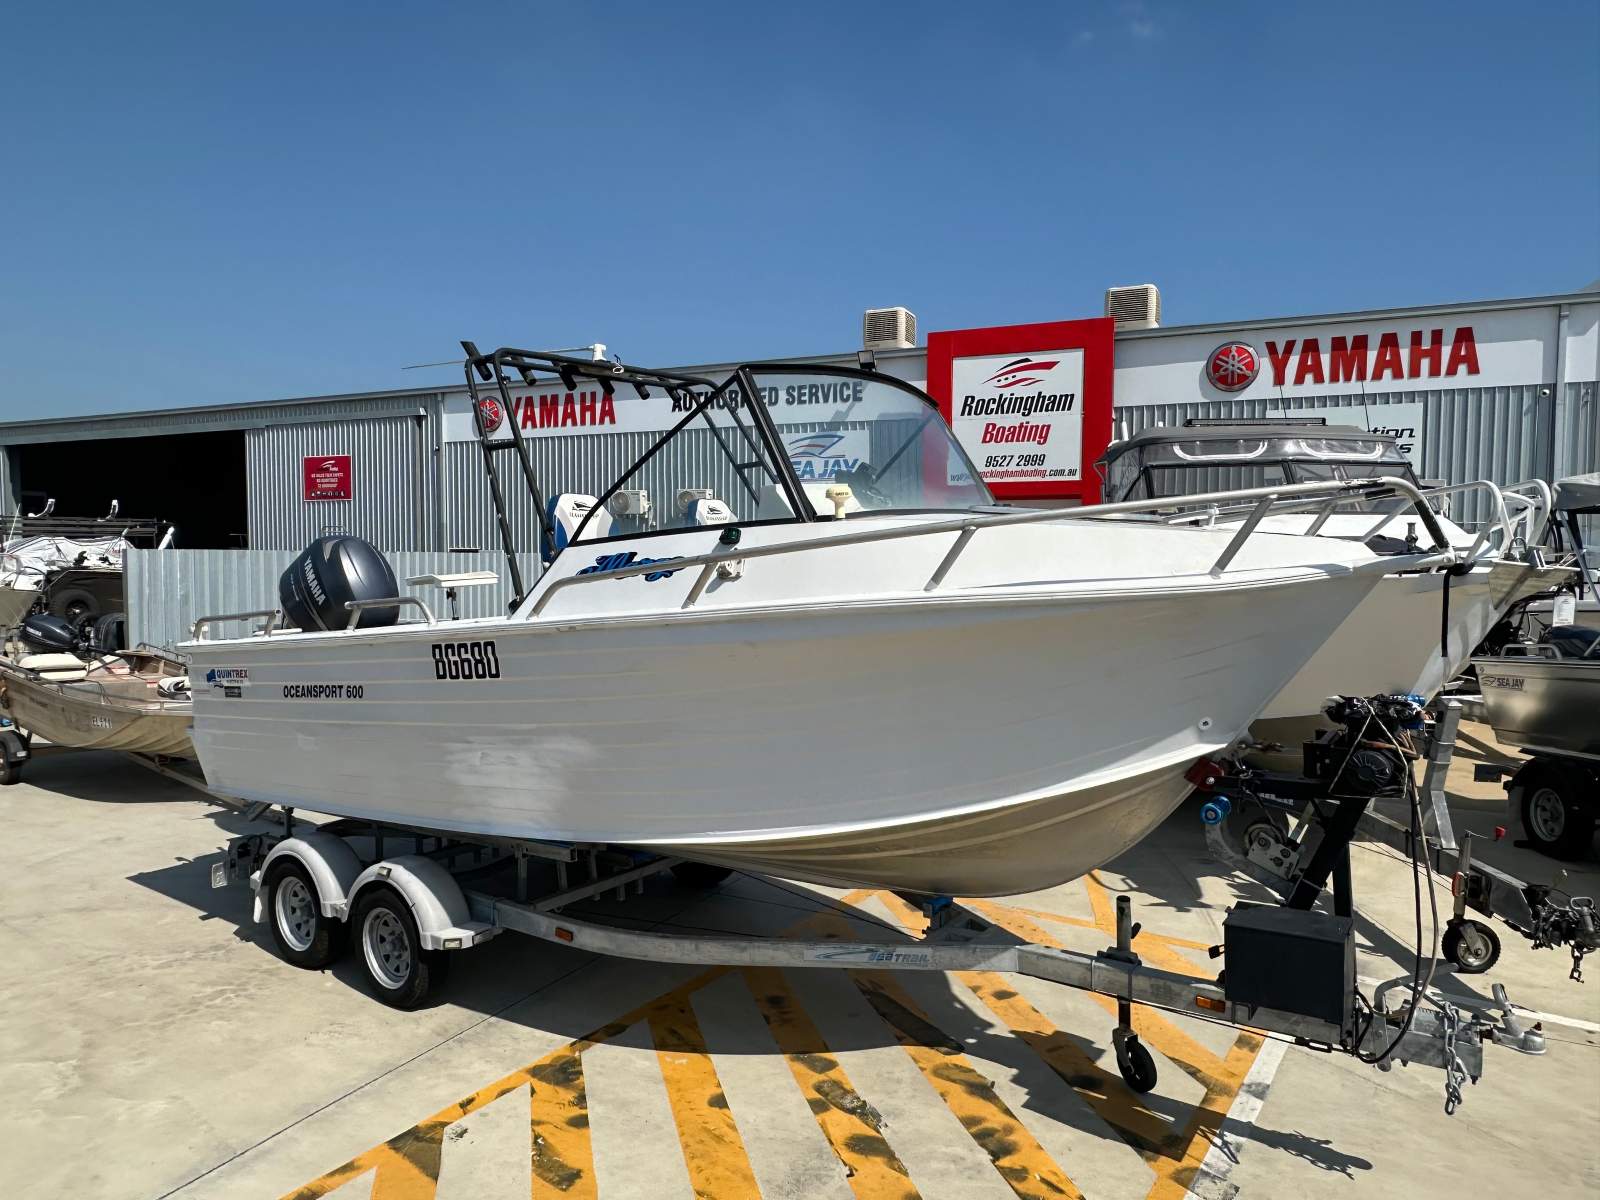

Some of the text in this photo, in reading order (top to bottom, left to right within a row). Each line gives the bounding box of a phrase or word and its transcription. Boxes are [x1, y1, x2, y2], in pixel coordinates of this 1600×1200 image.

[1265, 327, 1480, 386] YAMAHA
[672, 381, 863, 412] AUTHORIED SERVICE
[960, 391, 1075, 417] Rockingham
[981, 421, 1051, 445] Boating
[792, 460, 816, 478] EA
[985, 454, 1046, 468] 9527 2999
[304, 555, 327, 606] YAMAHA
[432, 640, 501, 680] BG680
[216, 669, 248, 679] QUINTREX
[283, 685, 364, 699] OCEANSPORT 600
